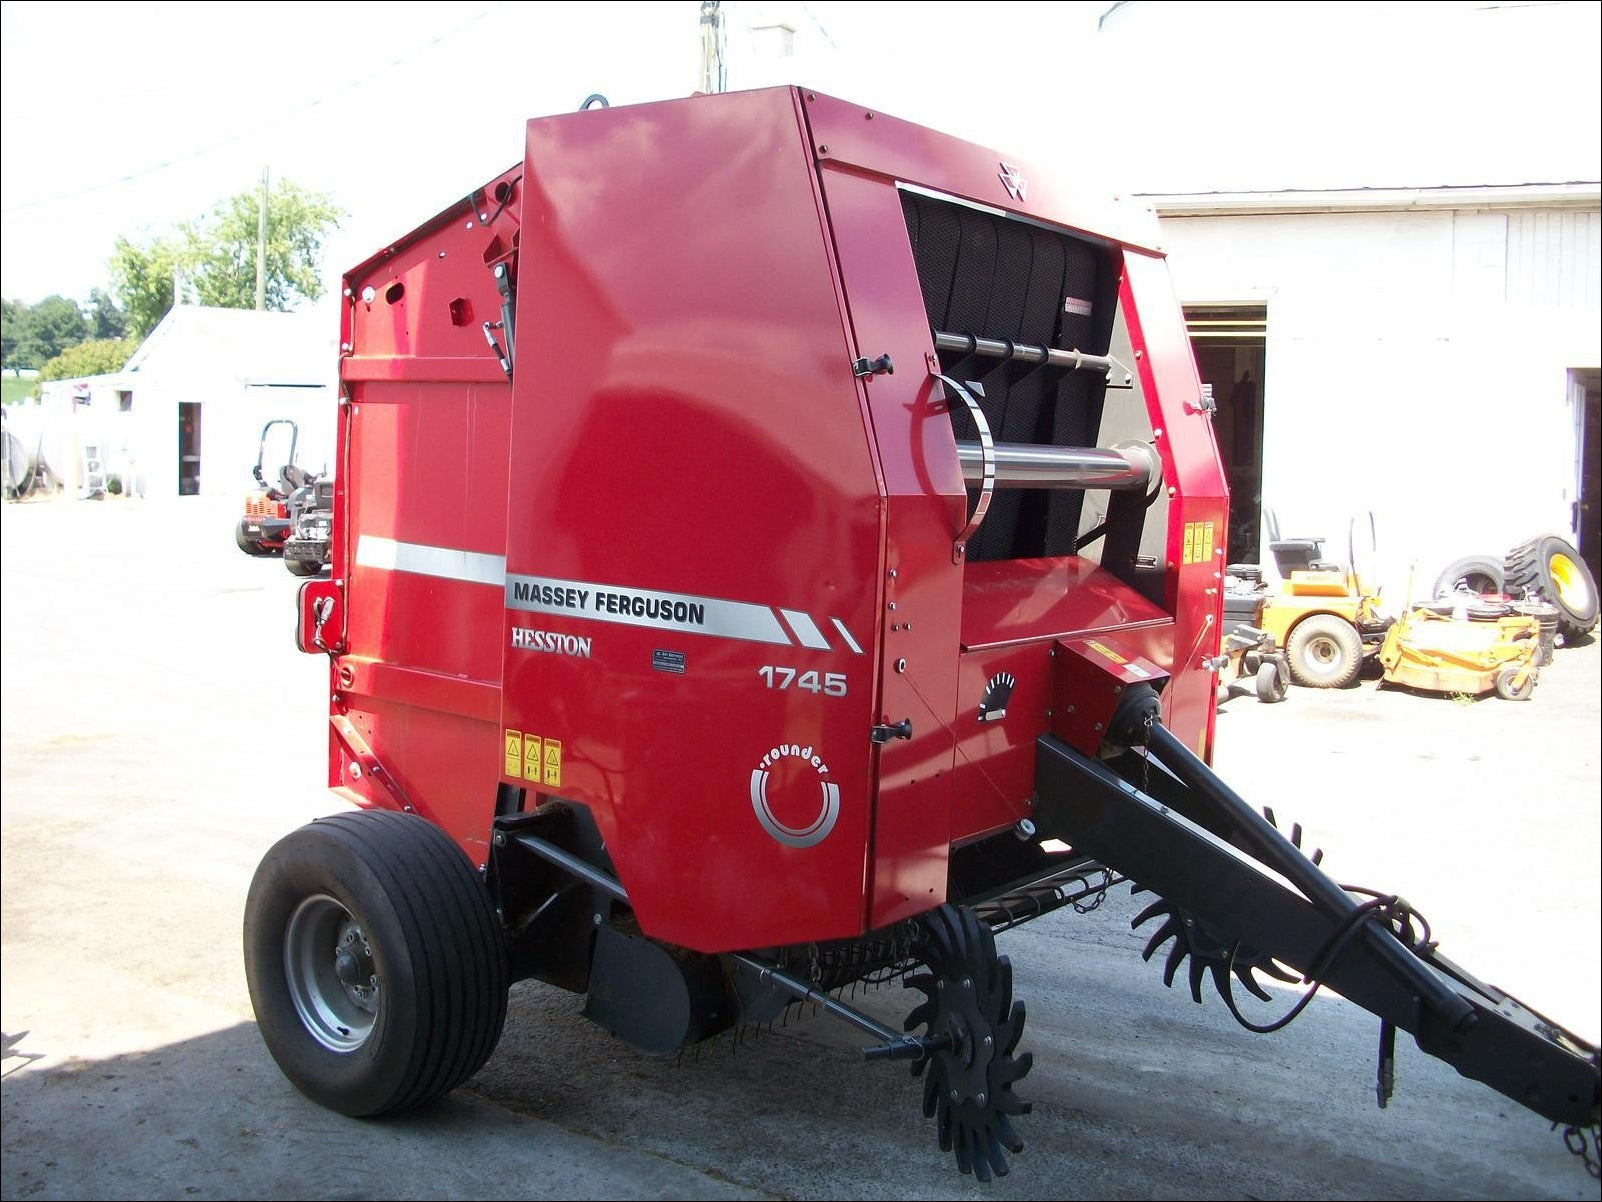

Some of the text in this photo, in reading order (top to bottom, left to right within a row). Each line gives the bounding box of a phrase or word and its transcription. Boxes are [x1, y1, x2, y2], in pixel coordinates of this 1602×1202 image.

[514, 582, 704, 625] MASSEY FERGUSON
[511, 627, 592, 658] HESSTON
[758, 666, 847, 697] 1745
